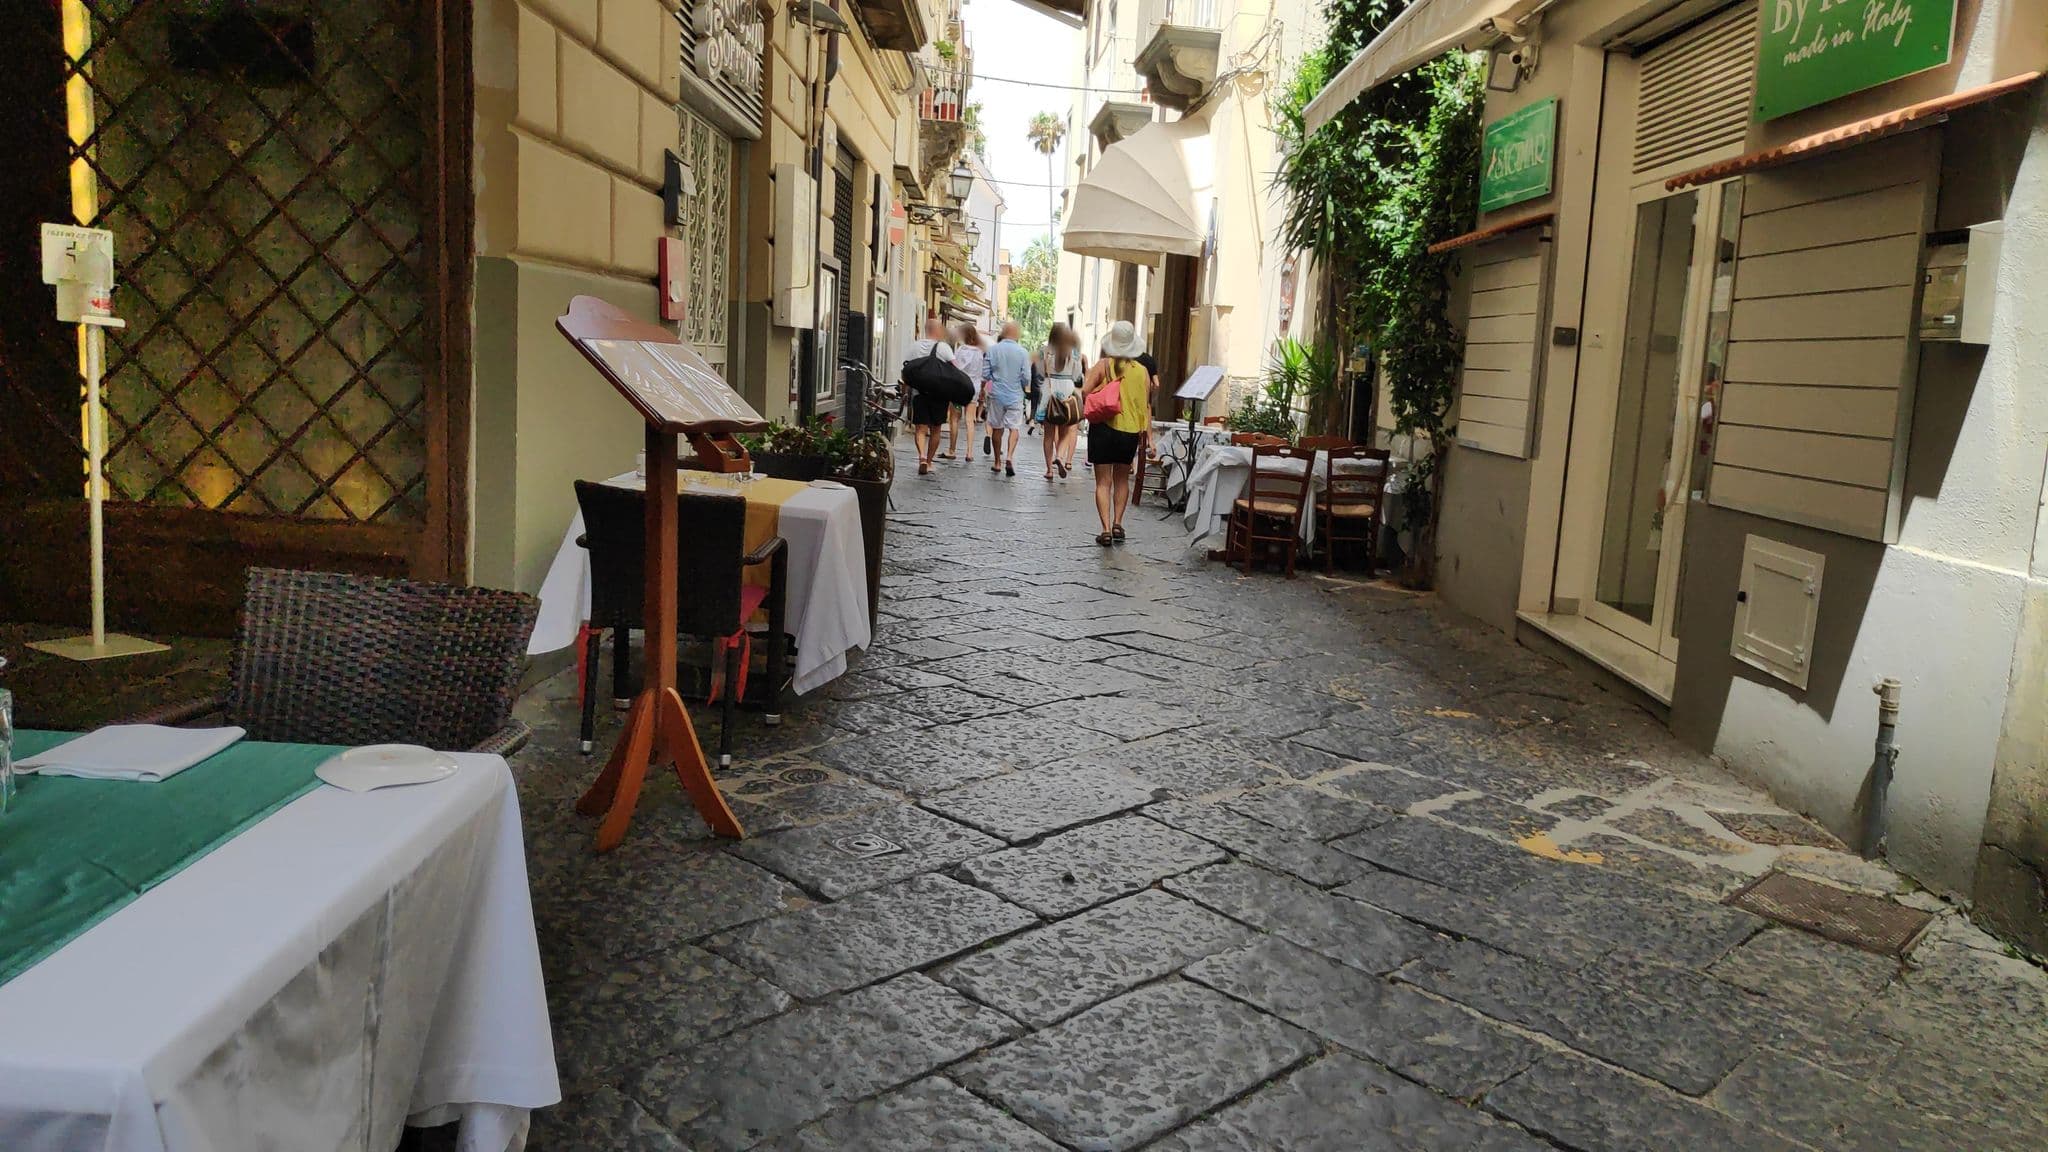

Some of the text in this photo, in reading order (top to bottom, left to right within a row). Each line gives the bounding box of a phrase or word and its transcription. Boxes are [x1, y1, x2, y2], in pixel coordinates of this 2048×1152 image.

[1783, 0, 1913, 66] made in Italy
